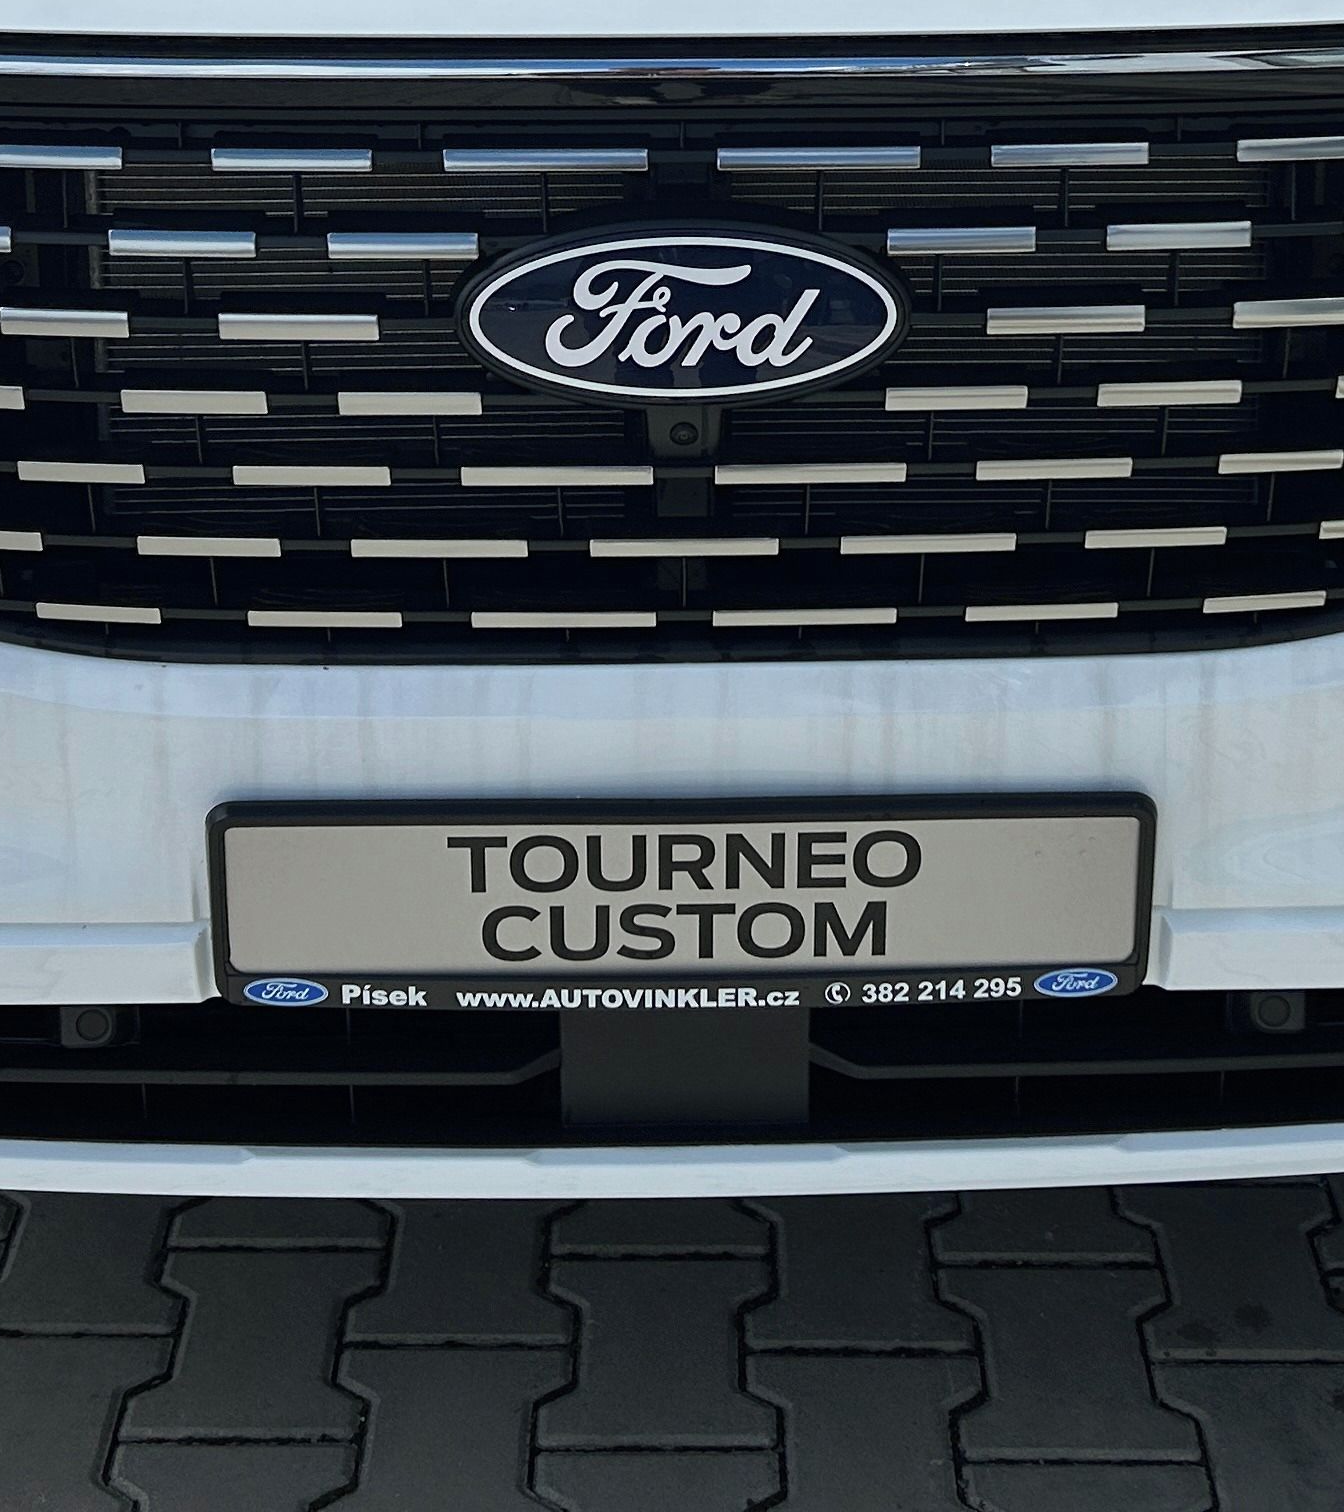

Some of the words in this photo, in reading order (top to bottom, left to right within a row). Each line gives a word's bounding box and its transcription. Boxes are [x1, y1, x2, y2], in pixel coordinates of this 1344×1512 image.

[545, 259, 821, 368] Ford
[446, 829, 922, 894] TOURNEO
[481, 900, 888, 962] CUSTOM
[261, 981, 309, 1001] Ford
[341, 984, 428, 1007] Písek
[456, 987, 801, 1009] www.AUTOVINKLER.cz
[861, 981, 910, 1004] 382
[917, 979, 966, 1001] 214
[973, 977, 1023, 999] 295
[1052, 971, 1099, 992] Ford
